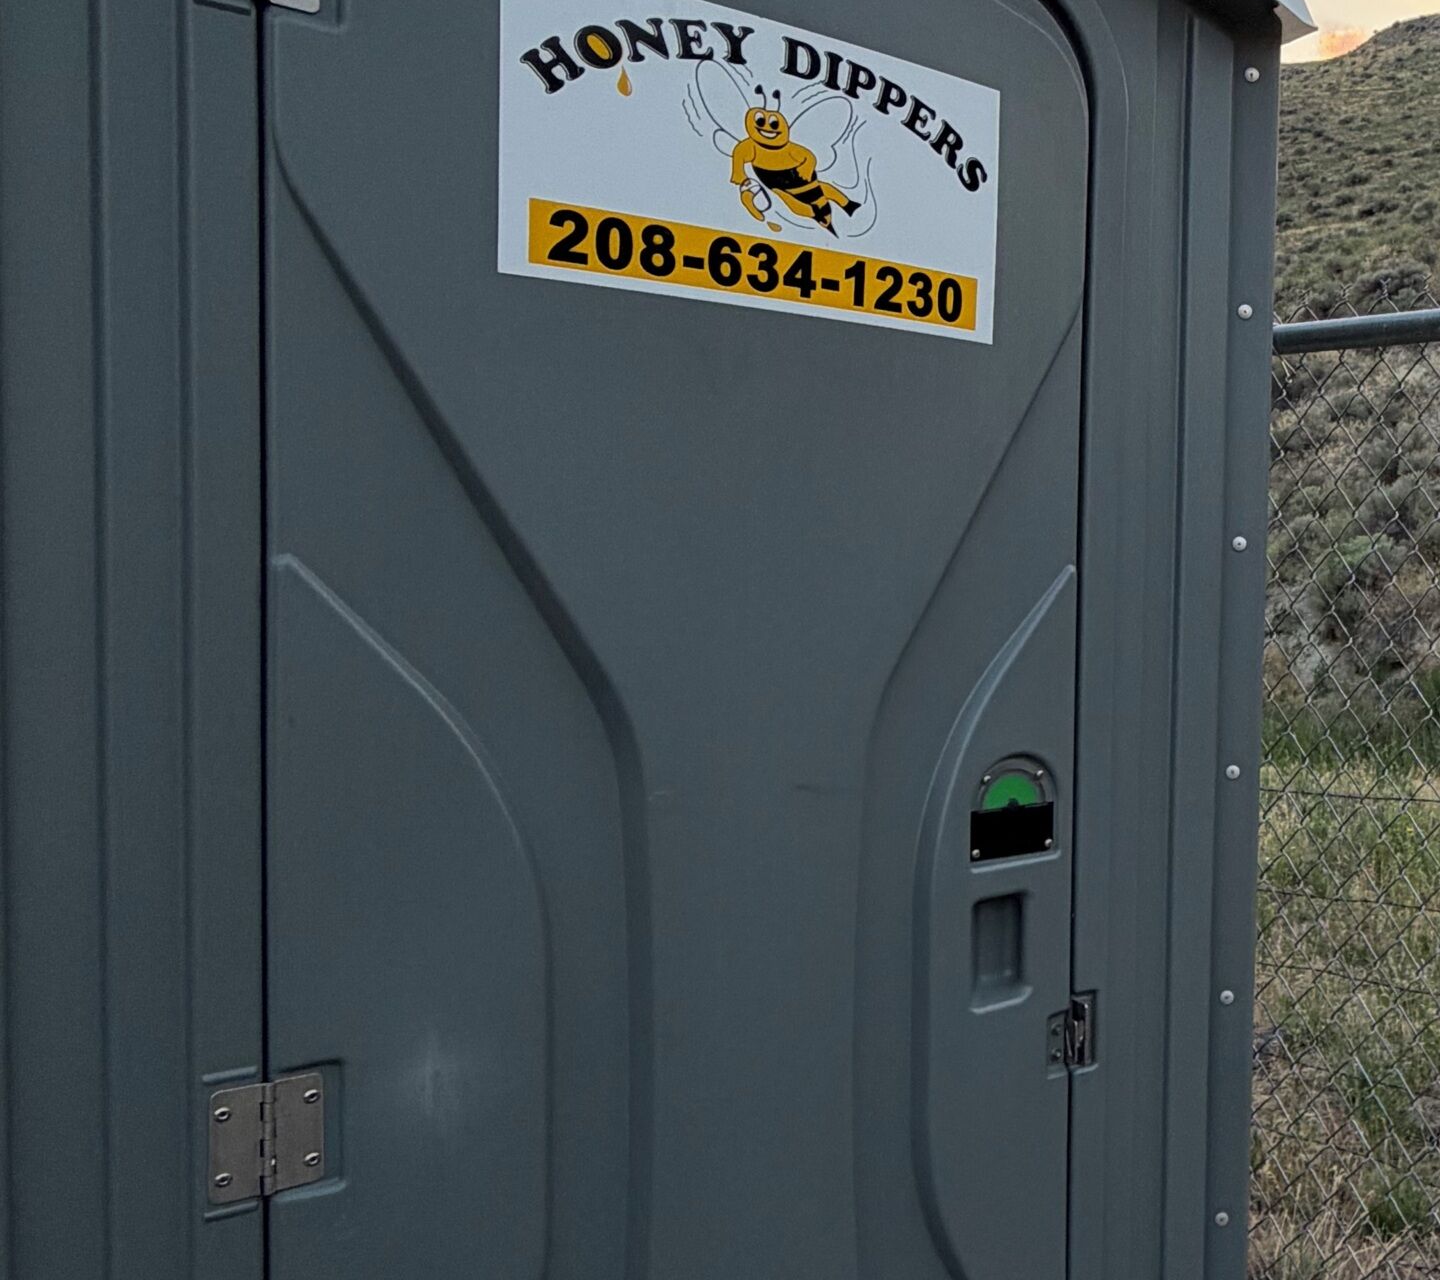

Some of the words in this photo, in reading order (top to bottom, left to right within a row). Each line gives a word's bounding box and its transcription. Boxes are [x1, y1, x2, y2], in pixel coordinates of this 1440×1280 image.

[519, 17, 755, 94] HONEY
[780, 36, 988, 193] DIPPERS
[547, 209, 963, 322] 208-634-1230
